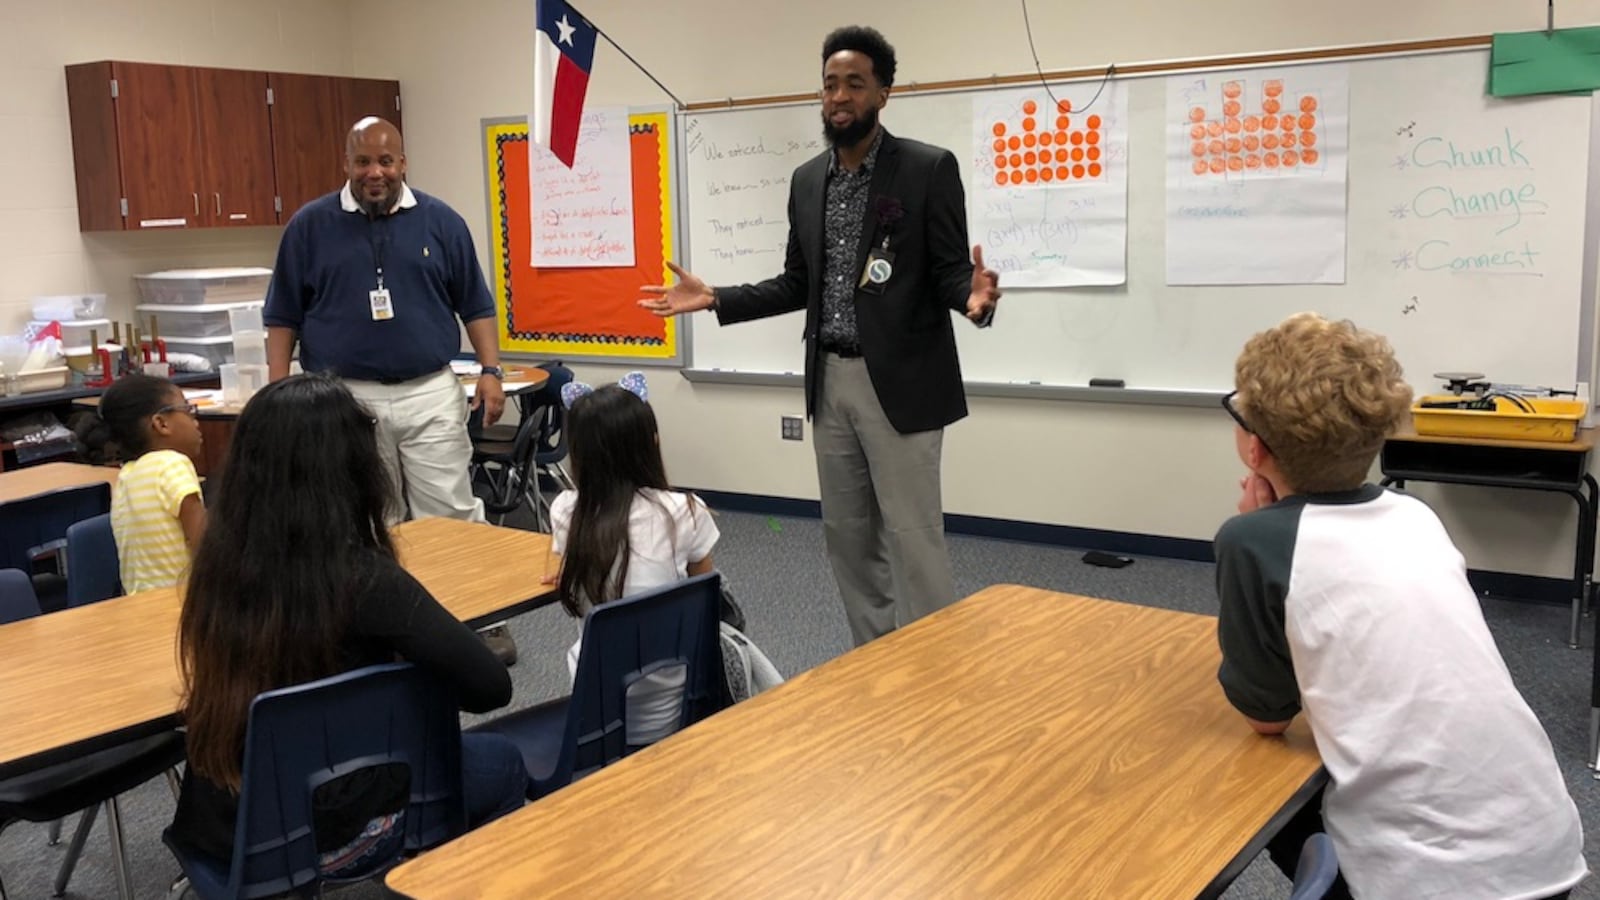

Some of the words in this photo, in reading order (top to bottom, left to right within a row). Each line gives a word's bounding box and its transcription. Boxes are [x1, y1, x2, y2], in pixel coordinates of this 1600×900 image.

[703, 142, 723, 161] We
[727, 136, 765, 158] noticed
[1412, 127, 1530, 169] Chunk
[1412, 183, 1549, 236] Change
[707, 218, 734, 238] They
[1415, 239, 1541, 271] Connect
